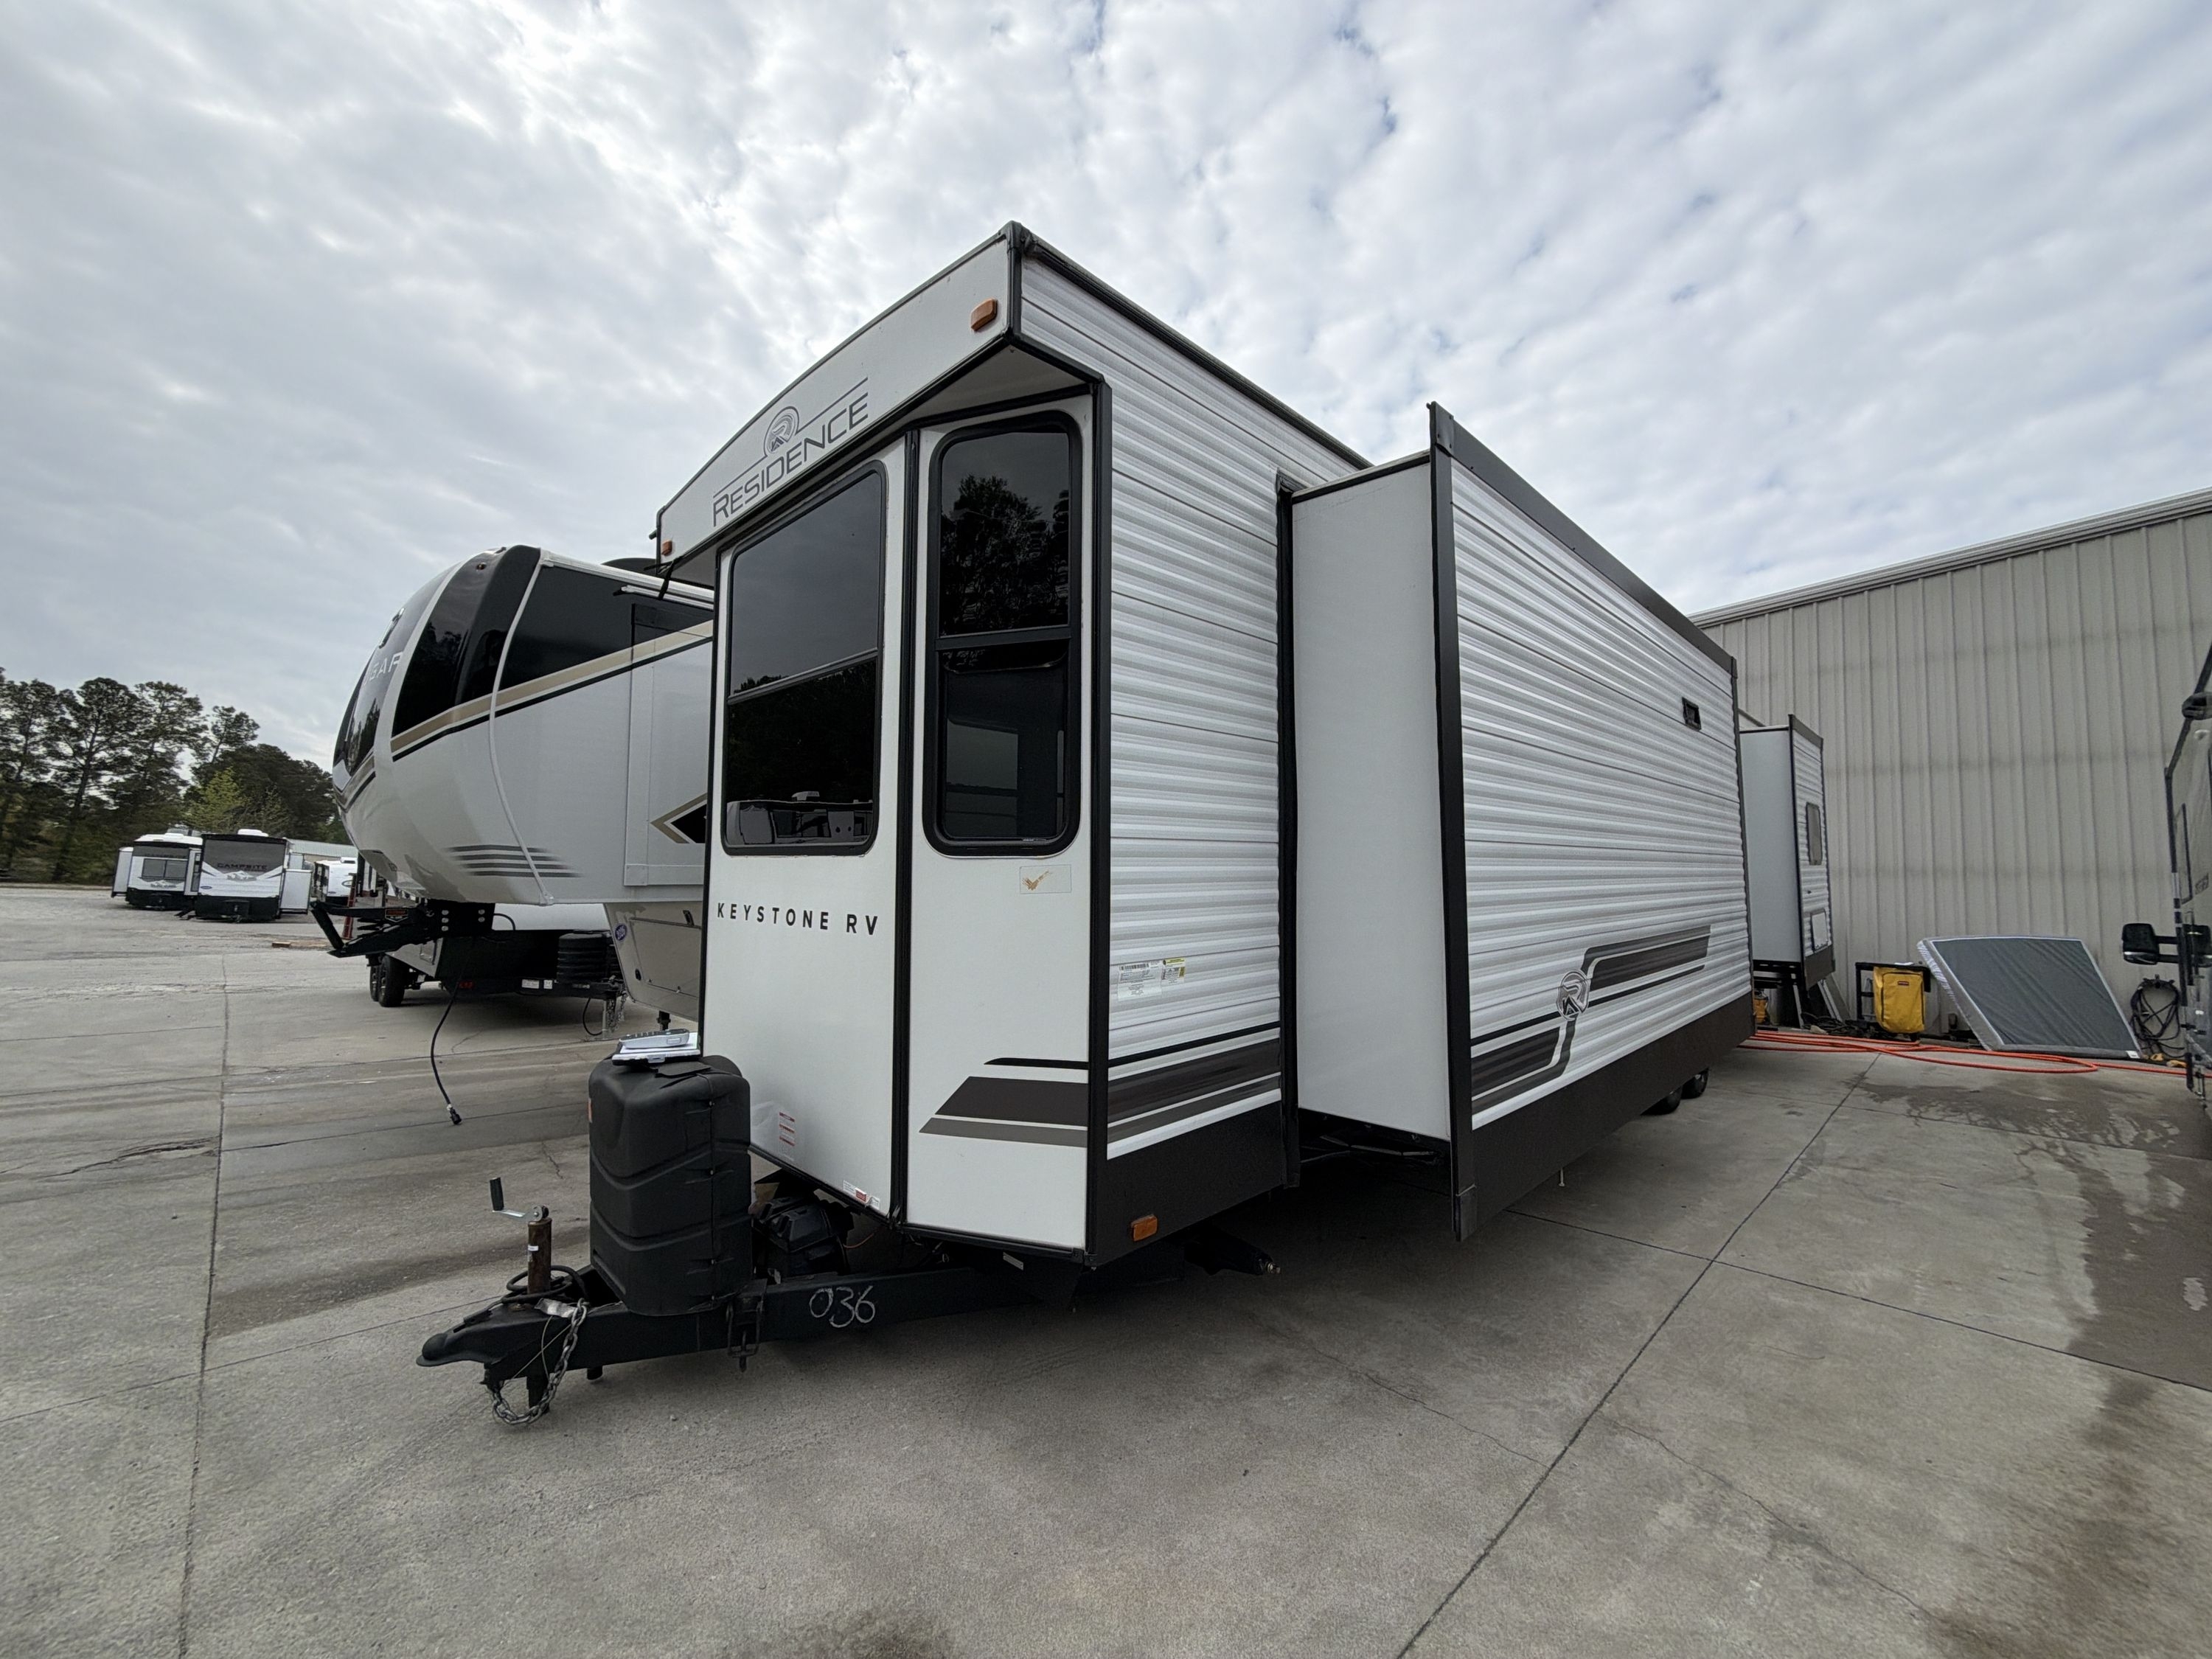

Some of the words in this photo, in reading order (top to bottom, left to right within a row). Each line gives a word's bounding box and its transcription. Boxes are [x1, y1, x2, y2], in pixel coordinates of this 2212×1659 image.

[712, 392, 869, 527] RESIDENCE
[717, 902, 829, 930] KEYSTONE
[846, 914, 878, 936] RV
[809, 1285, 876, 1328] 036
